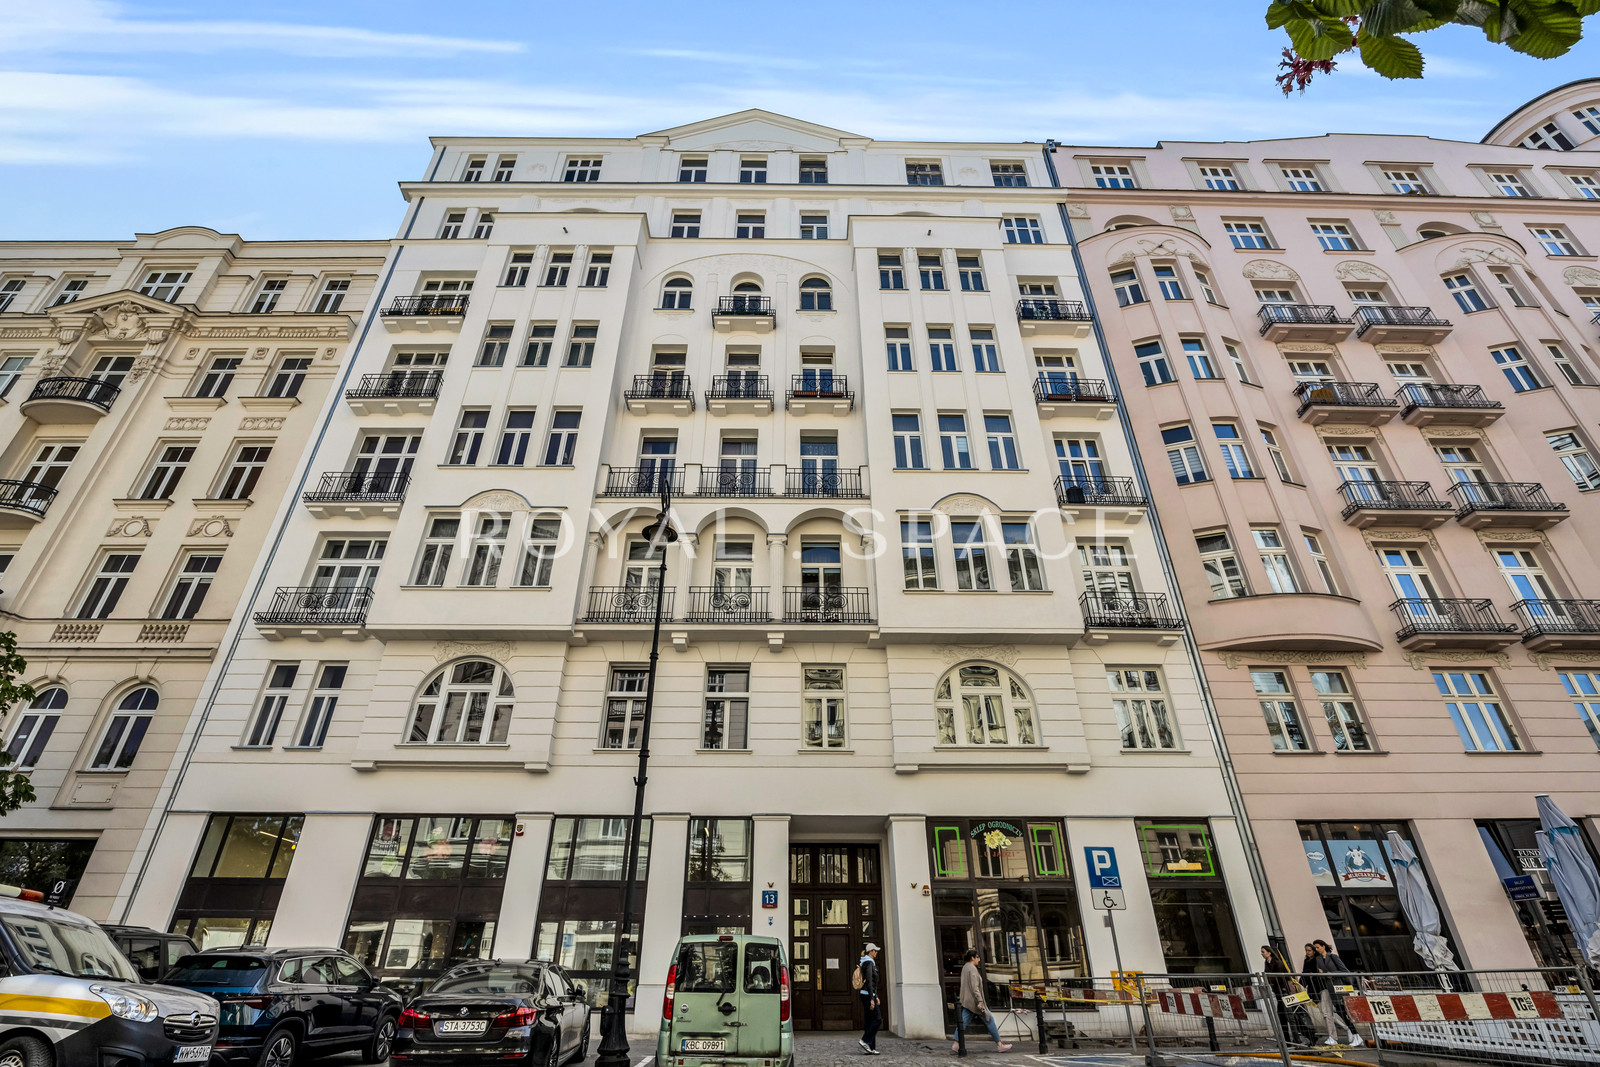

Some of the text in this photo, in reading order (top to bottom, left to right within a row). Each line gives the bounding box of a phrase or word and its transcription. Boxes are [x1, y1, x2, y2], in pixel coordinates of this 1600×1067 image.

[970, 821, 1022, 838] SKLEP OGRODNICZY
[1091, 850, 1111, 876] P
[765, 894, 775, 904] 13
[1370, 1001, 1386, 1015] TG
[1511, 996, 1528, 1012] TG
[444, 1021, 486, 1031] STA 3753C
[685, 1041, 724, 1050] KBC 09891
[179, 1047, 190, 1059] WW
